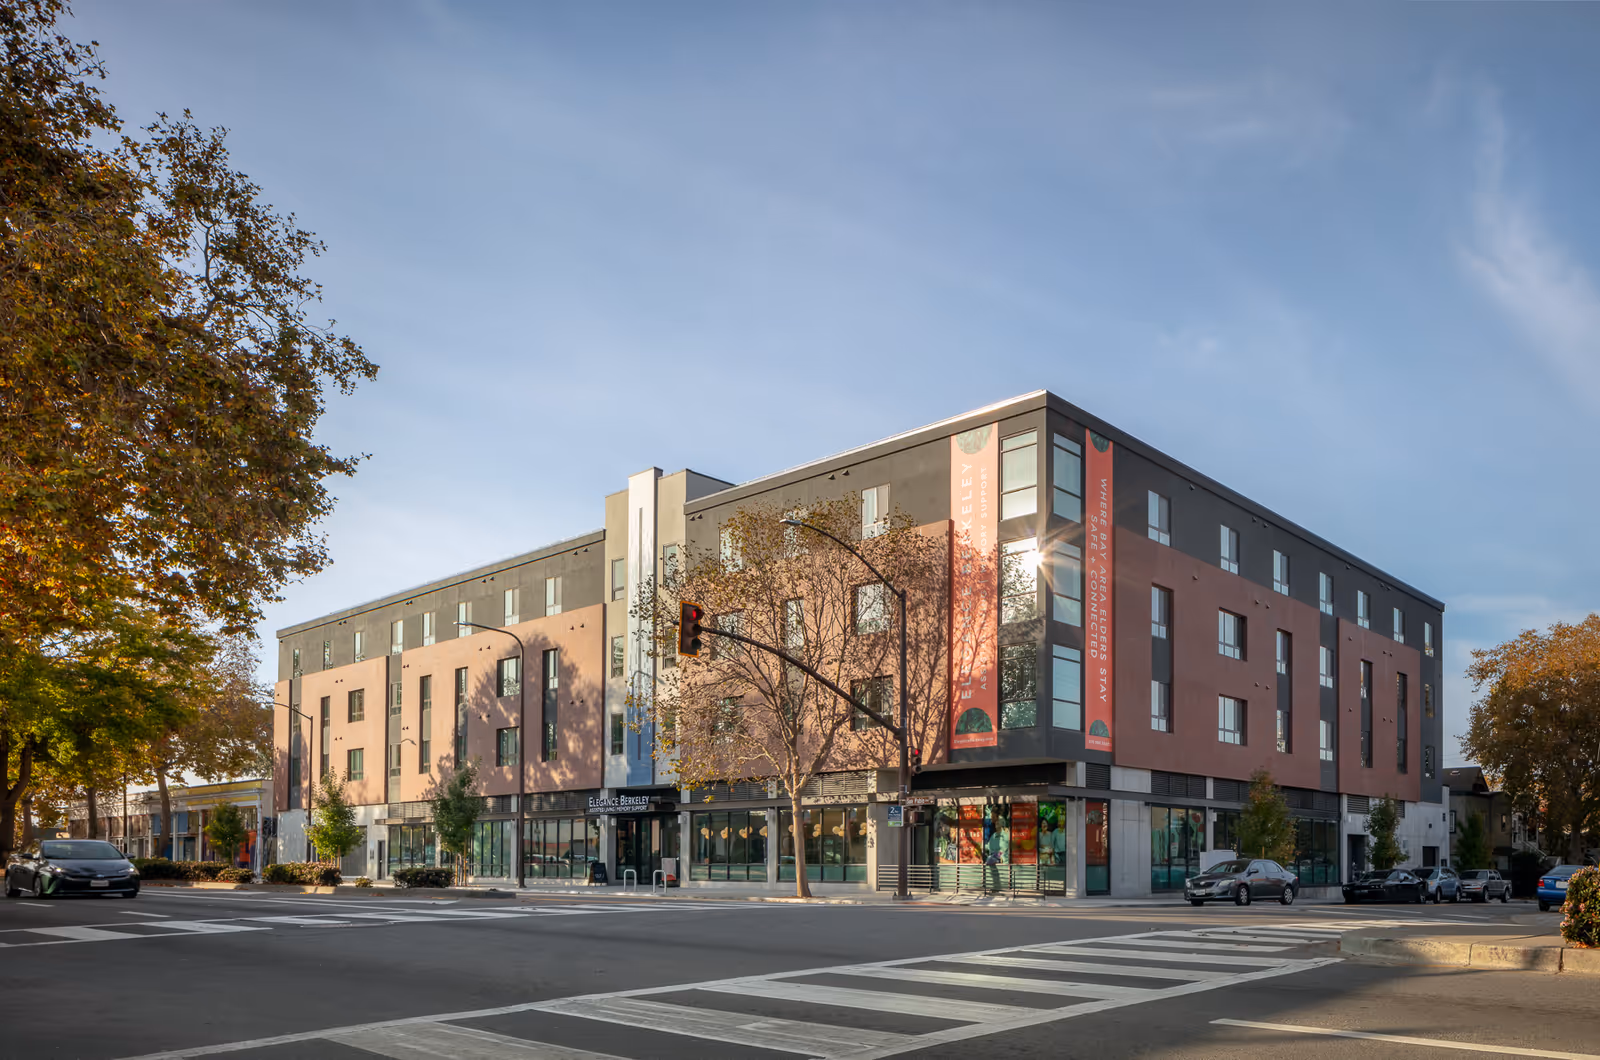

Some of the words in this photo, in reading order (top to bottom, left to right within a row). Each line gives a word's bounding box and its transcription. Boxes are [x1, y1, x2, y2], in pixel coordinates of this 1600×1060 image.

[961, 463, 972, 574] BERKELEY
[961, 586, 972, 699] ELEGANCE
[1090, 570, 1098, 658] CONNECTED
[589, 797, 618, 807] ELEGANCE
[620, 795, 649, 805] BERKELEY
